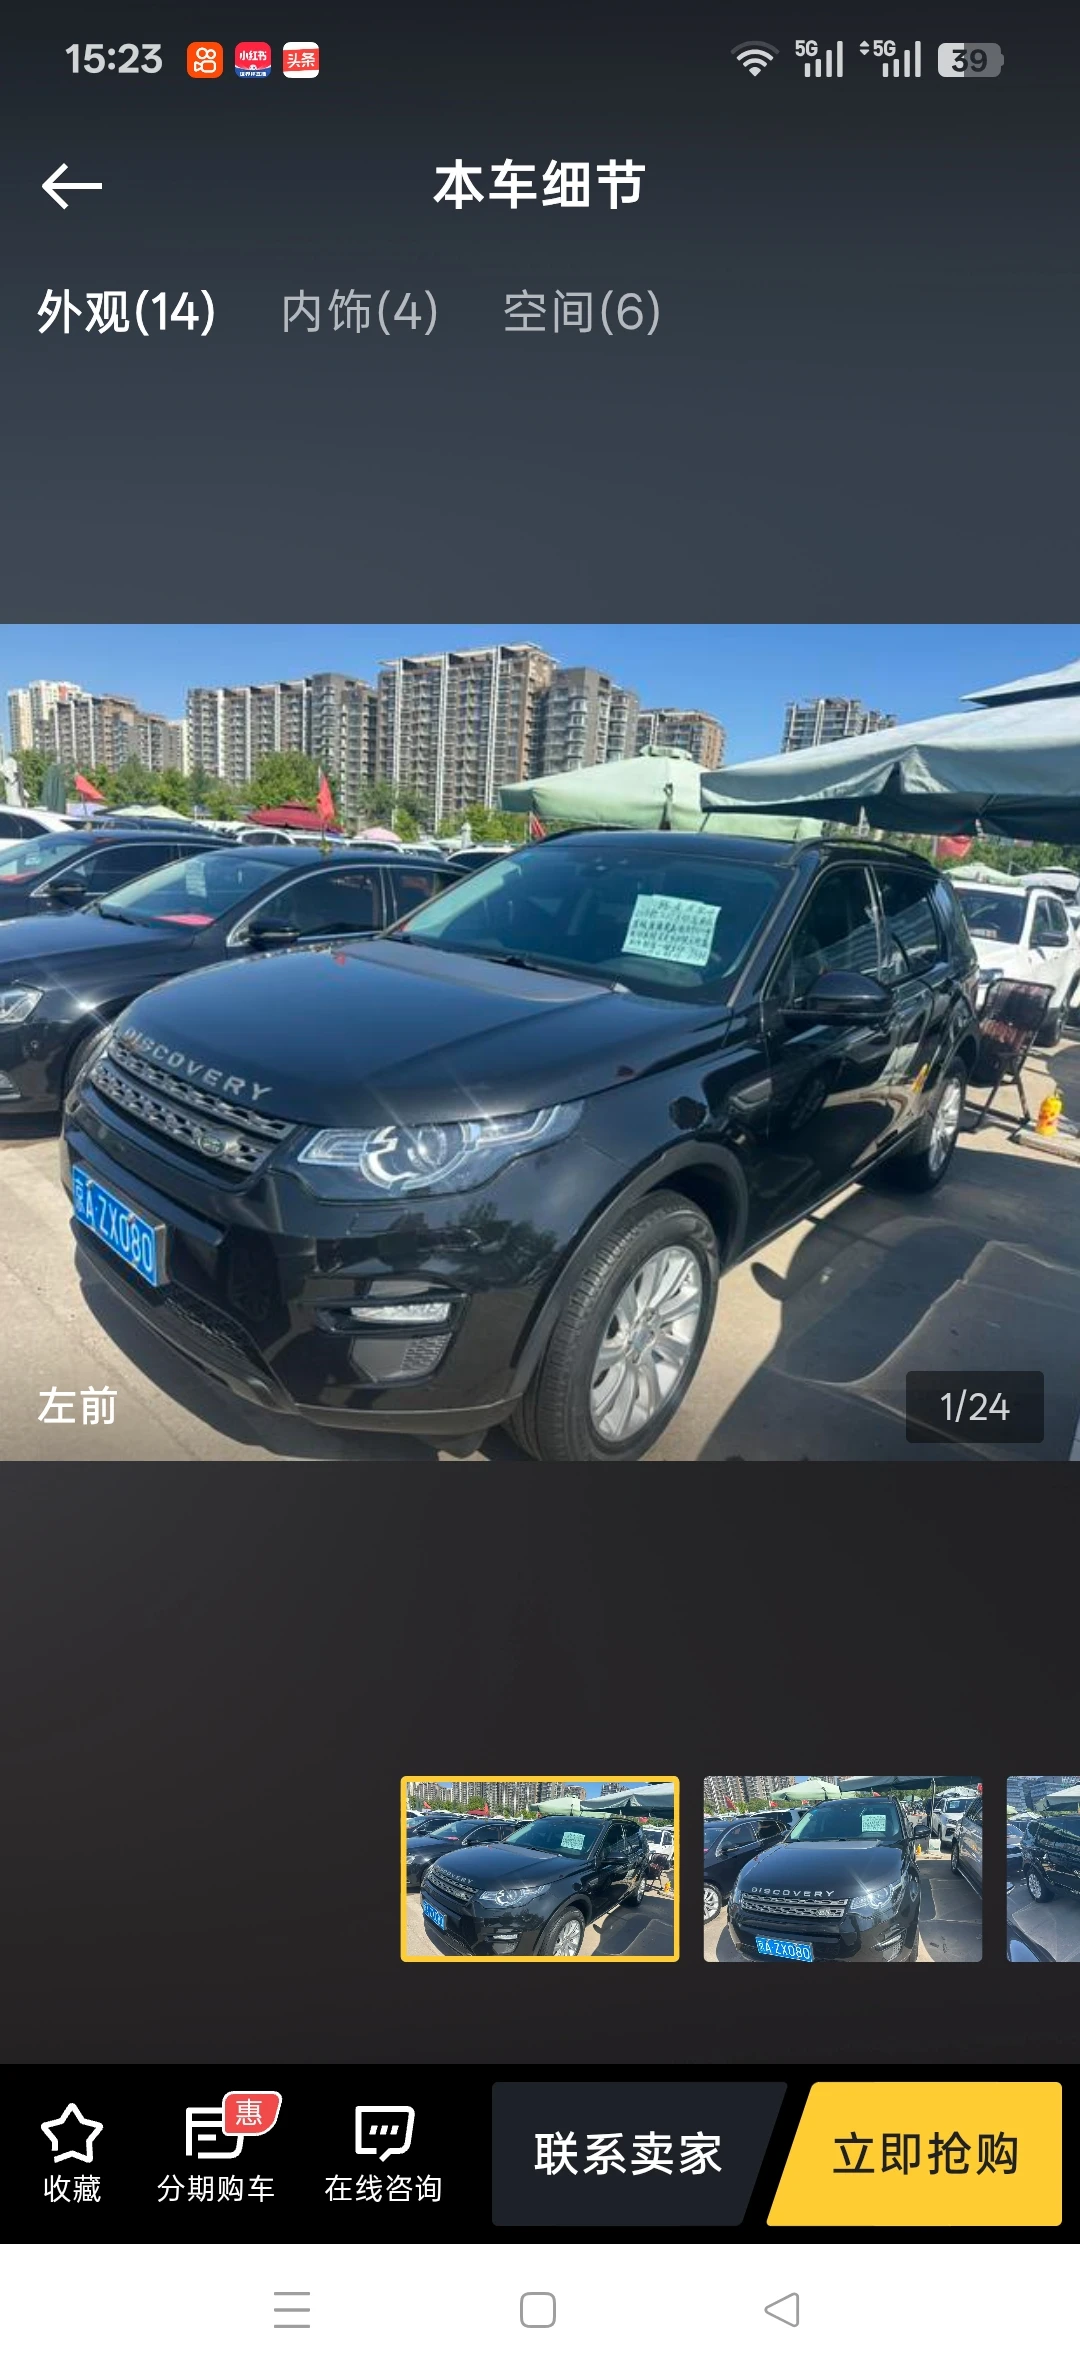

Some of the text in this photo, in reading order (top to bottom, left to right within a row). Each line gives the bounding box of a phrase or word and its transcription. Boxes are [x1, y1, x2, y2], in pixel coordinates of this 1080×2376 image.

[66, 43, 162, 74] 15:23
[240, 50, 267, 61] 小红书
[287, 52, 316, 69] 头条
[795, 40, 819, 57] 5G
[873, 40, 897, 57] 5G
[951, 49, 988, 72] 39
[433, 158, 646, 210] 本车细节
[37, 289, 215, 336] 外观(14)
[283, 289, 437, 336] 内饰(4)
[504, 289, 660, 336] 空间(6)
[124, 1026, 273, 1101] DISCOVERY
[751, 1886, 835, 1898] DISCOVERY
[235, 2098, 263, 2126] 惠
[534, 2131, 723, 2176] 联系卖家
[832, 2131, 1018, 2176] 立即抢购
[43, 2174, 102, 2204] 收藏
[156, 2174, 275, 2203] 分期购车
[324, 2174, 442, 2203] 在线咨询
